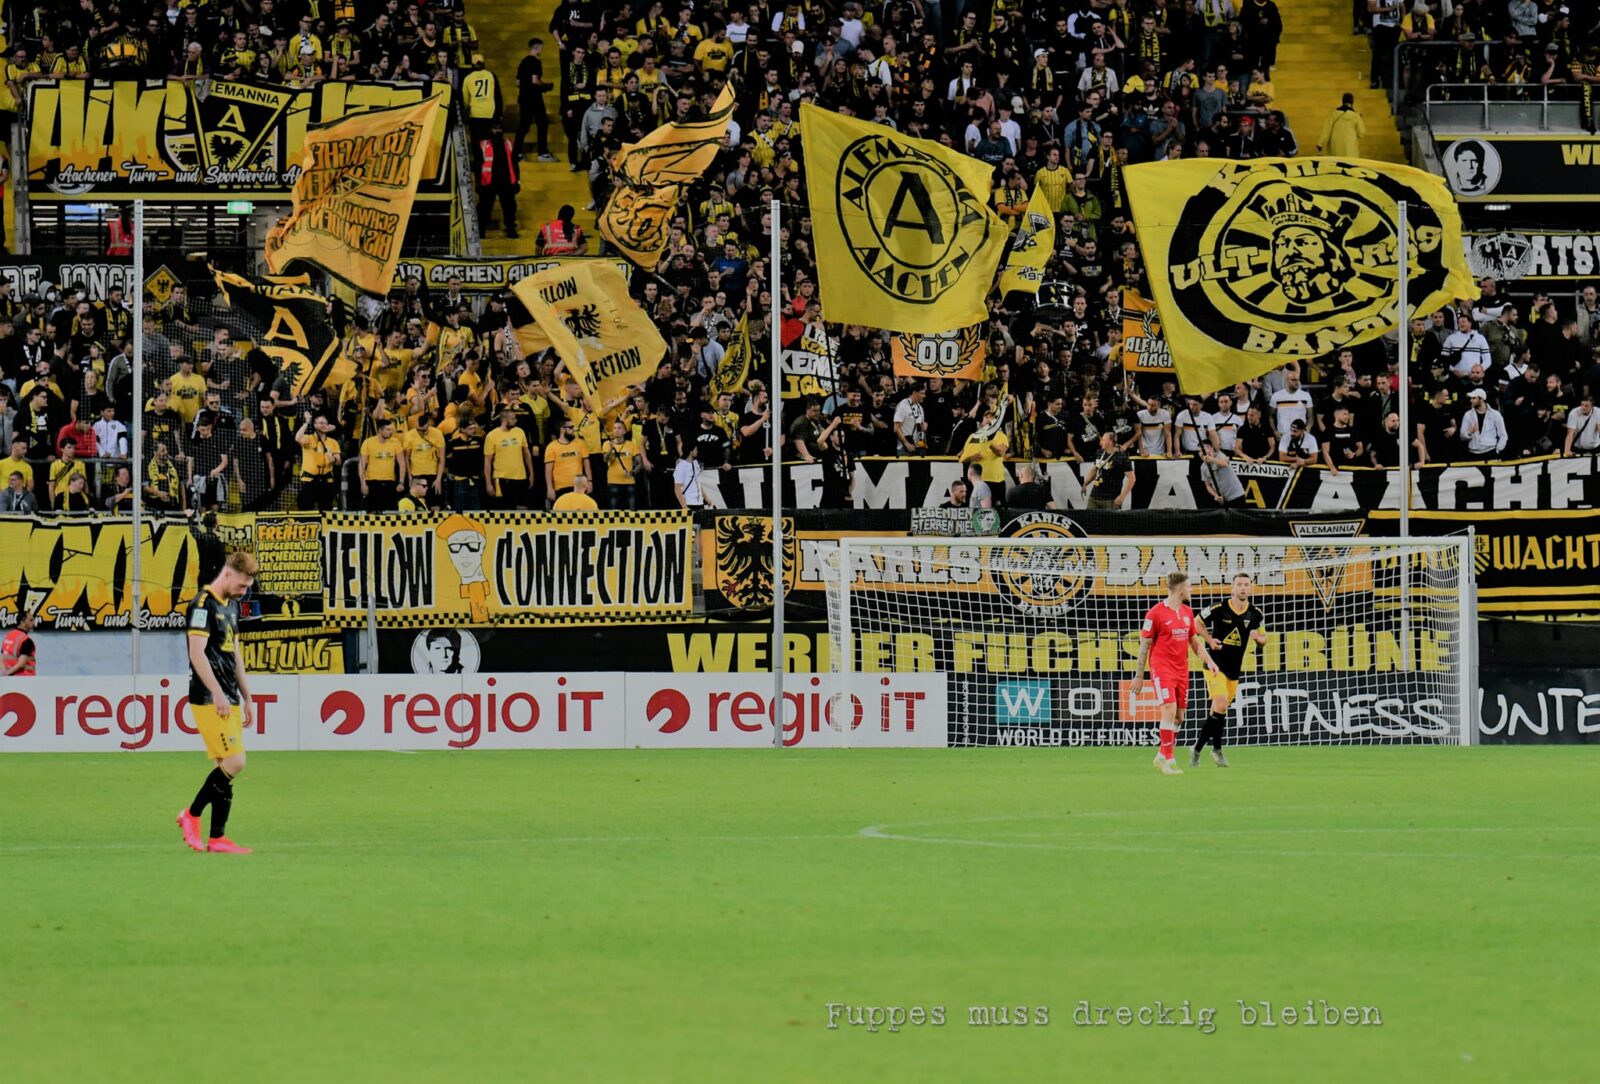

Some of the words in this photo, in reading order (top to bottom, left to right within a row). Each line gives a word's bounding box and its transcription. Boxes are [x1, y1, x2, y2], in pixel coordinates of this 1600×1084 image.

[213, 83, 280, 106] EMANNIA
[474, 79, 489, 97] 21
[217, 104, 246, 132] A
[58, 164, 117, 182] Aachener
[121, 162, 168, 184] Turn-
[175, 167, 199, 183] und
[204, 165, 278, 184] Sportverein
[883, 171, 944, 244] A
[1530, 236, 1600, 275] ATS
[429, 264, 504, 283] AACHEN
[264, 306, 309, 350] A
[1126, 336, 1169, 354] ALEMA
[1232, 464, 1290, 478] EMANNIA
[1310, 457, 1600, 509] AACHE
[911, 507, 974, 519] LEGENDEN
[1017, 513, 1072, 529] KARLS
[1299, 525, 1356, 534] ALEMANNIA
[259, 550, 319, 562] SICHERHEIT
[800, 540, 982, 583] KARLS
[1105, 544, 1285, 586] BANDE
[321, 529, 434, 609] YELLOW
[495, 527, 688, 608] CONNECTION
[274, 581, 320, 591] VERLIEREN
[104, 611, 130, 628] und
[239, 638, 331, 670] ALTUNG
[384, 677, 540, 748] regio
[709, 676, 864, 747] regio
[1231, 681, 1452, 736] FITNESS
[997, 728, 1062, 746] WORLD
[1068, 728, 1093, 746] OF
[1098, 727, 1162, 746] FITNES
